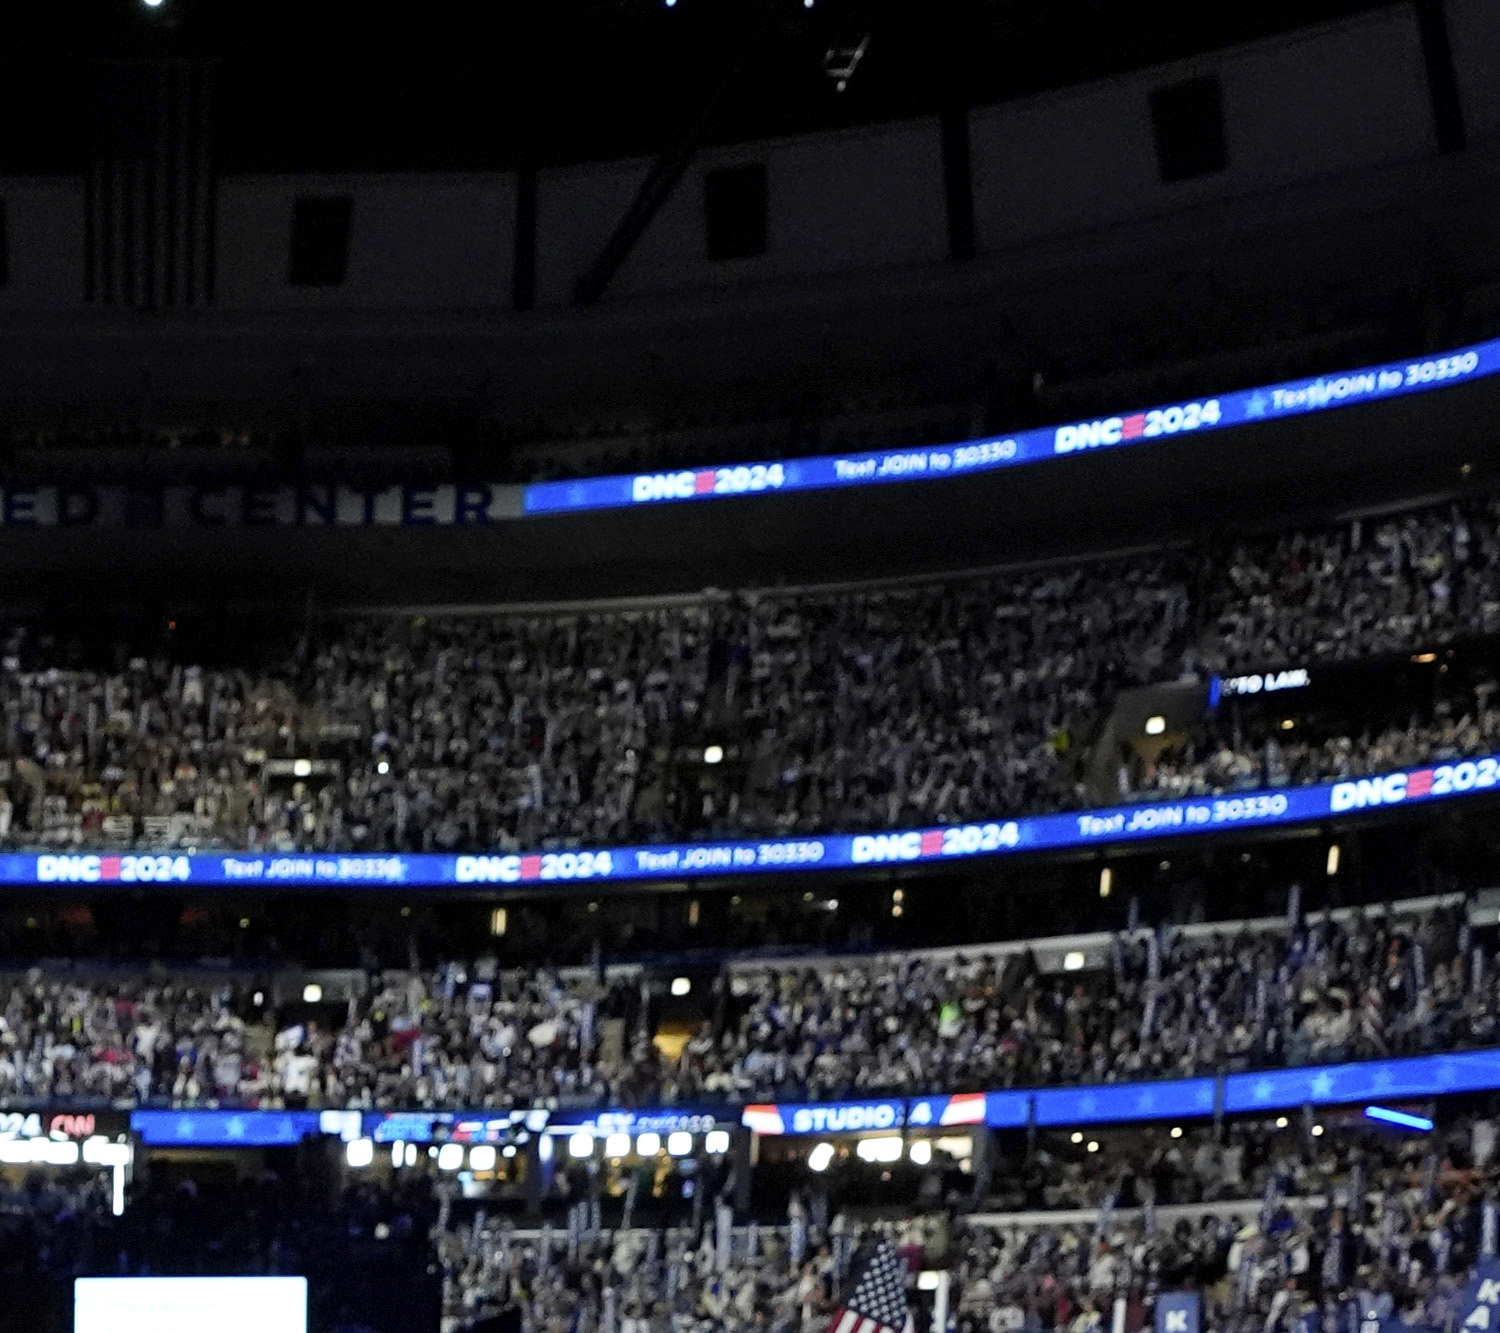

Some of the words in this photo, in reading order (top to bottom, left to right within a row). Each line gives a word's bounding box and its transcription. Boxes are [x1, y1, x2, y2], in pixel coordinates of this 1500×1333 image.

[1055, 418, 1127, 452] DNC
[1136, 400, 1221, 437] 2024
[633, 472, 701, 500] DNC
[707, 464, 785, 493] 2024
[198, 487, 496, 525] CENTER
[1331, 774, 1410, 811] DNC
[852, 832, 927, 862] DNC
[935, 822, 1020, 854] 2024
[38, 856, 107, 881] DNC
[113, 856, 190, 880] 2024
[456, 856, 526, 881] DNC
[536, 852, 612, 879] 2024
[794, 1105, 894, 1131] STUDIO
